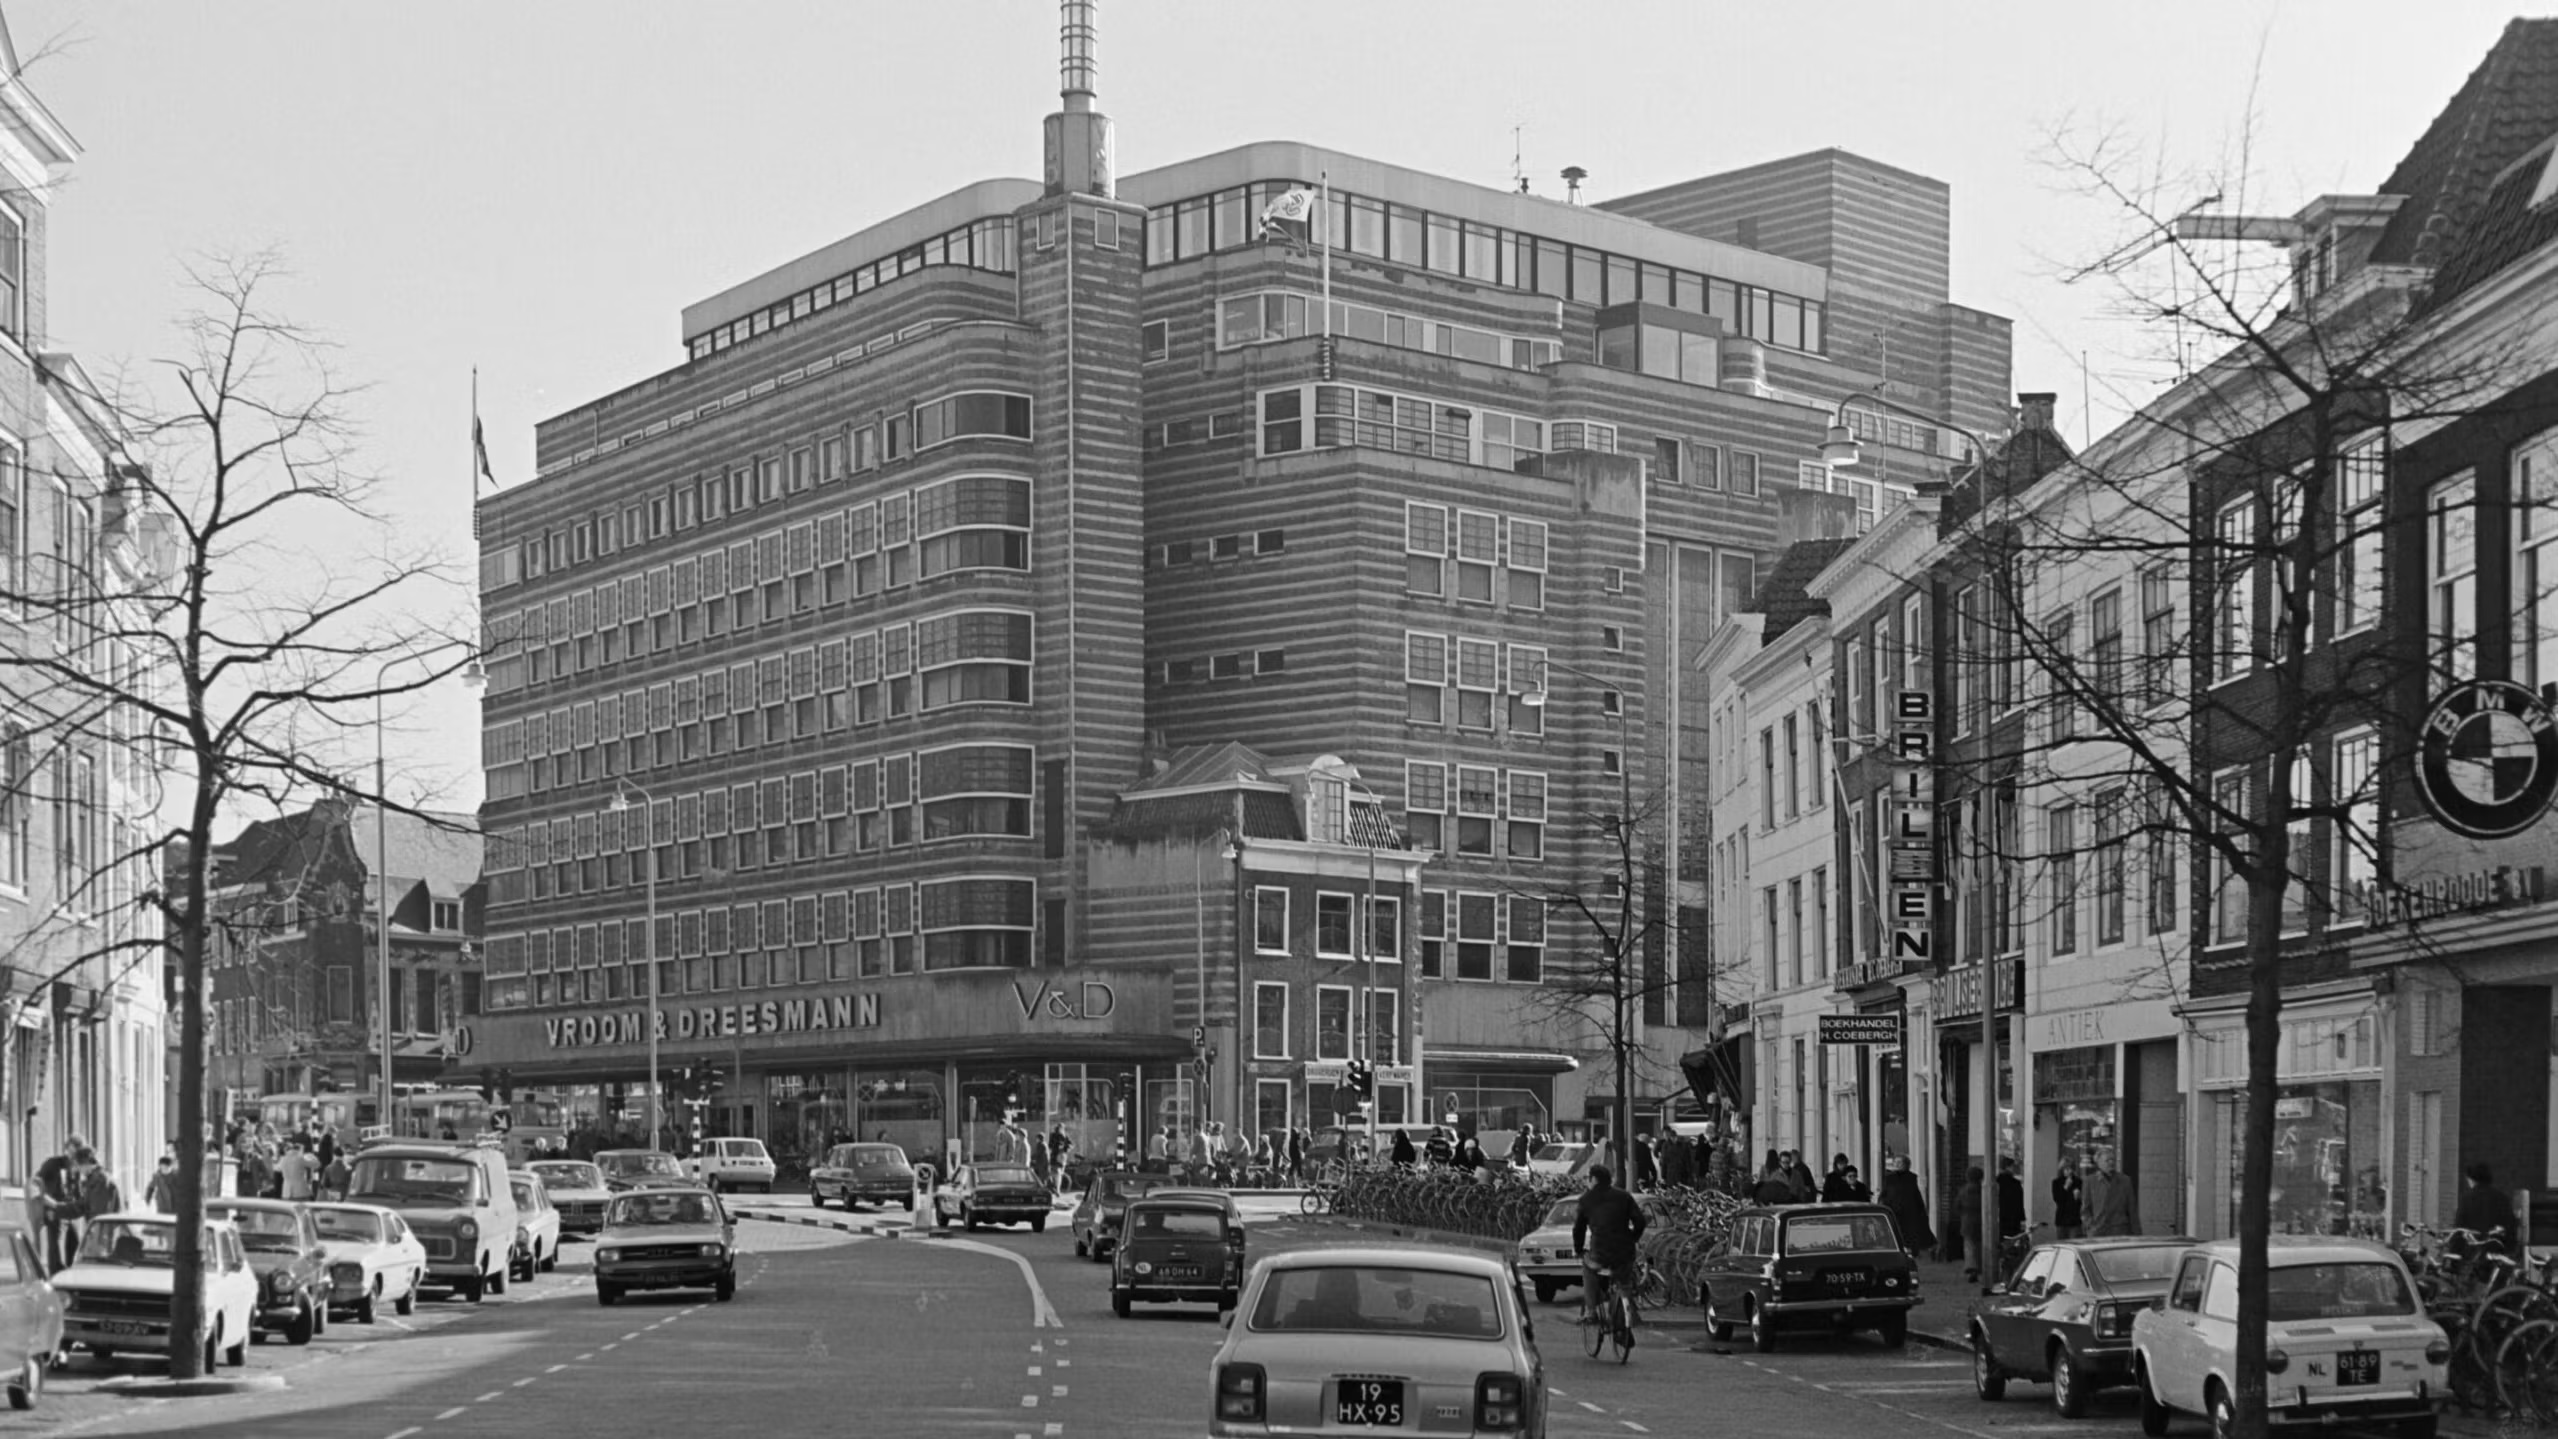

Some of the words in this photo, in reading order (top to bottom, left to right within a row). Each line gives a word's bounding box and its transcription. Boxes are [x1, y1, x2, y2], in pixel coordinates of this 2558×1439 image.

[2432, 687, 2552, 735] BMW
[1895, 692, 1928, 956] BRILEN
[1012, 981, 1116, 1019] V&D
[1931, 959, 2015, 1020] BRILSERICE
[546, 1013, 642, 1047] VROOM
[656, 1010, 668, 1040] &
[678, 994, 878, 1038] DREESMANN
[1820, 1018, 1896, 1029] BOEKHANDEL
[1834, 1030, 1897, 1041] COEBERGH
[2048, 1009, 2105, 1046] ANTIEK
[2308, 1362, 2326, 1377] NL
[2349, 1369, 2367, 1383] TE
[1361, 1383, 1381, 1401] 19
